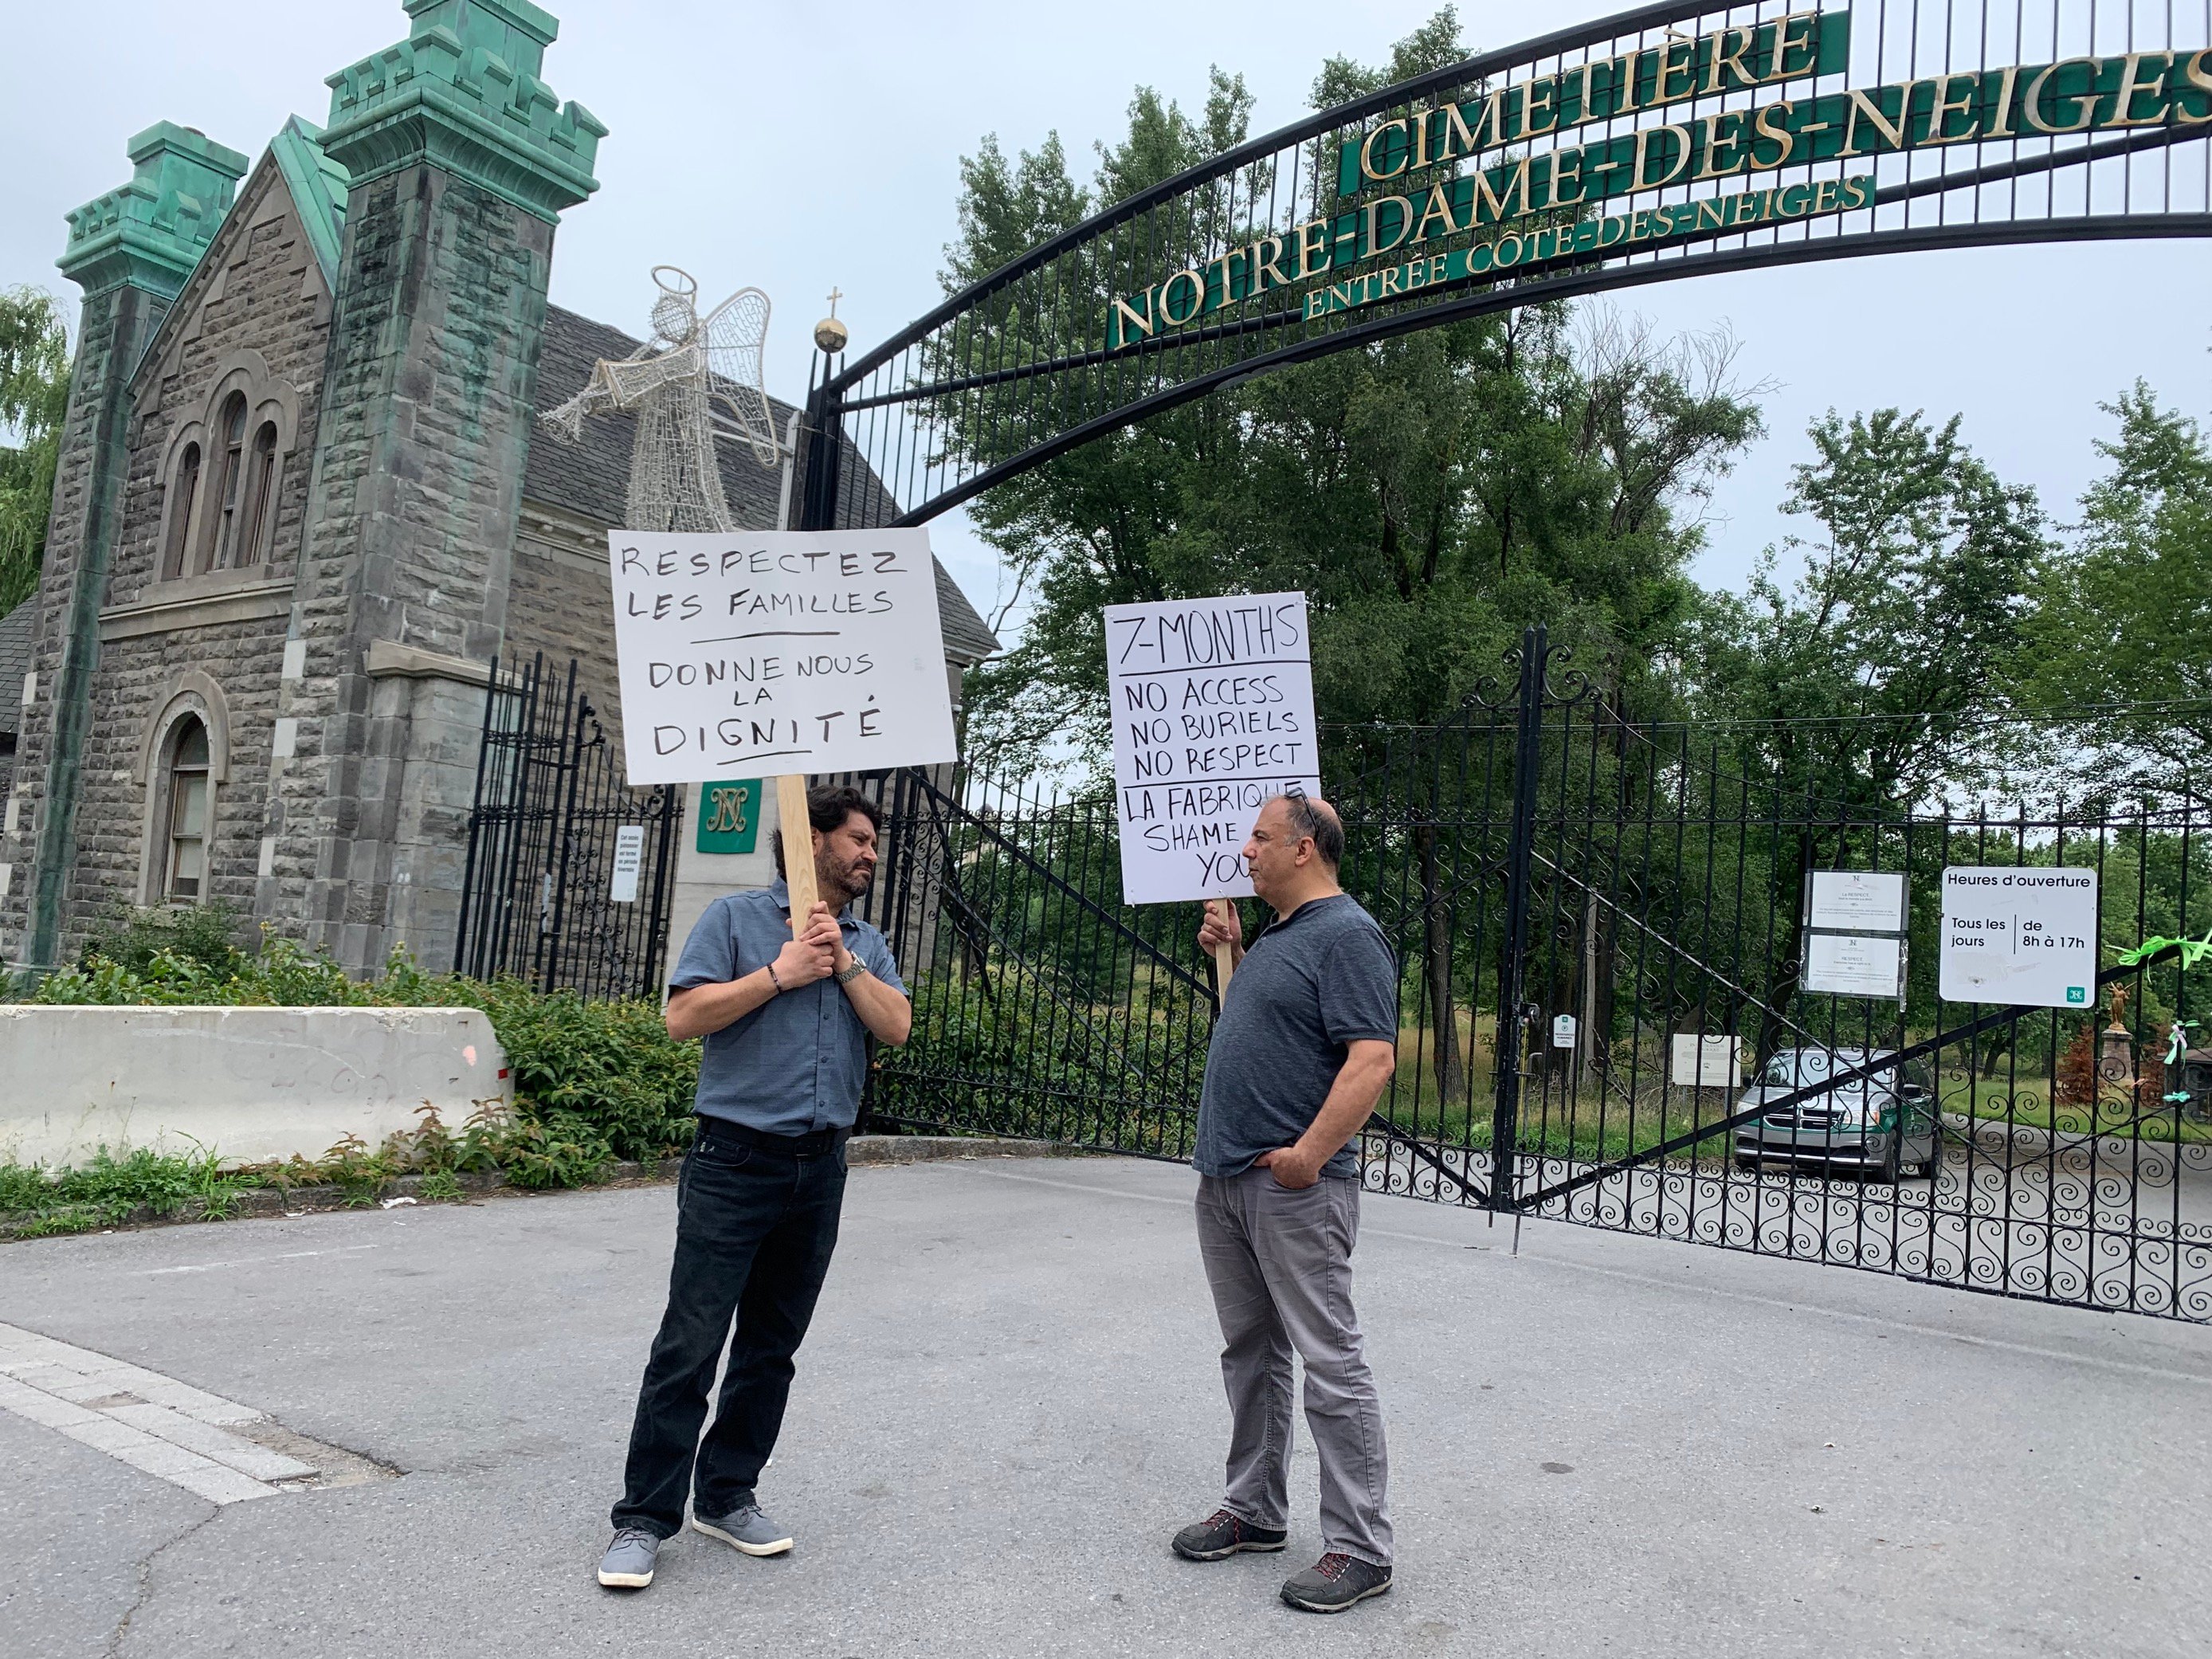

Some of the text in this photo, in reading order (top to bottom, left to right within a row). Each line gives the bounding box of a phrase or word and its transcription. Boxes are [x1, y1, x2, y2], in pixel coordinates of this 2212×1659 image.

[1360, 10, 1818, 180] CIMETIÈRE
[1304, 174, 1866, 320] ENTRÉE CÔTE-DES-NEIGES
[622, 547, 908, 578] RESPECTEZ
[628, 588, 894, 621] LES FAMILLES
[1113, 604, 1299, 665] 7-MONTHS
[649, 653, 874, 688] DONNE NOUS
[733, 687, 773, 707] LA
[1125, 675, 1284, 712] NO ACCESS
[653, 695, 883, 756] DIGNITÉ
[1131, 712, 1299, 748] NO BURIELS
[1135, 743, 1303, 780] NO RESPECT
[1124, 786, 1155, 822] LA
[1143, 822, 1241, 852] SHAME
[1947, 873, 2091, 888] Heures d'ouverture
[1951, 917, 2006, 930] Tous les
[2023, 920, 2042, 931] de
[1951, 935, 1985, 947] jours
[2022, 935, 2085, 948] 8h à 17h
